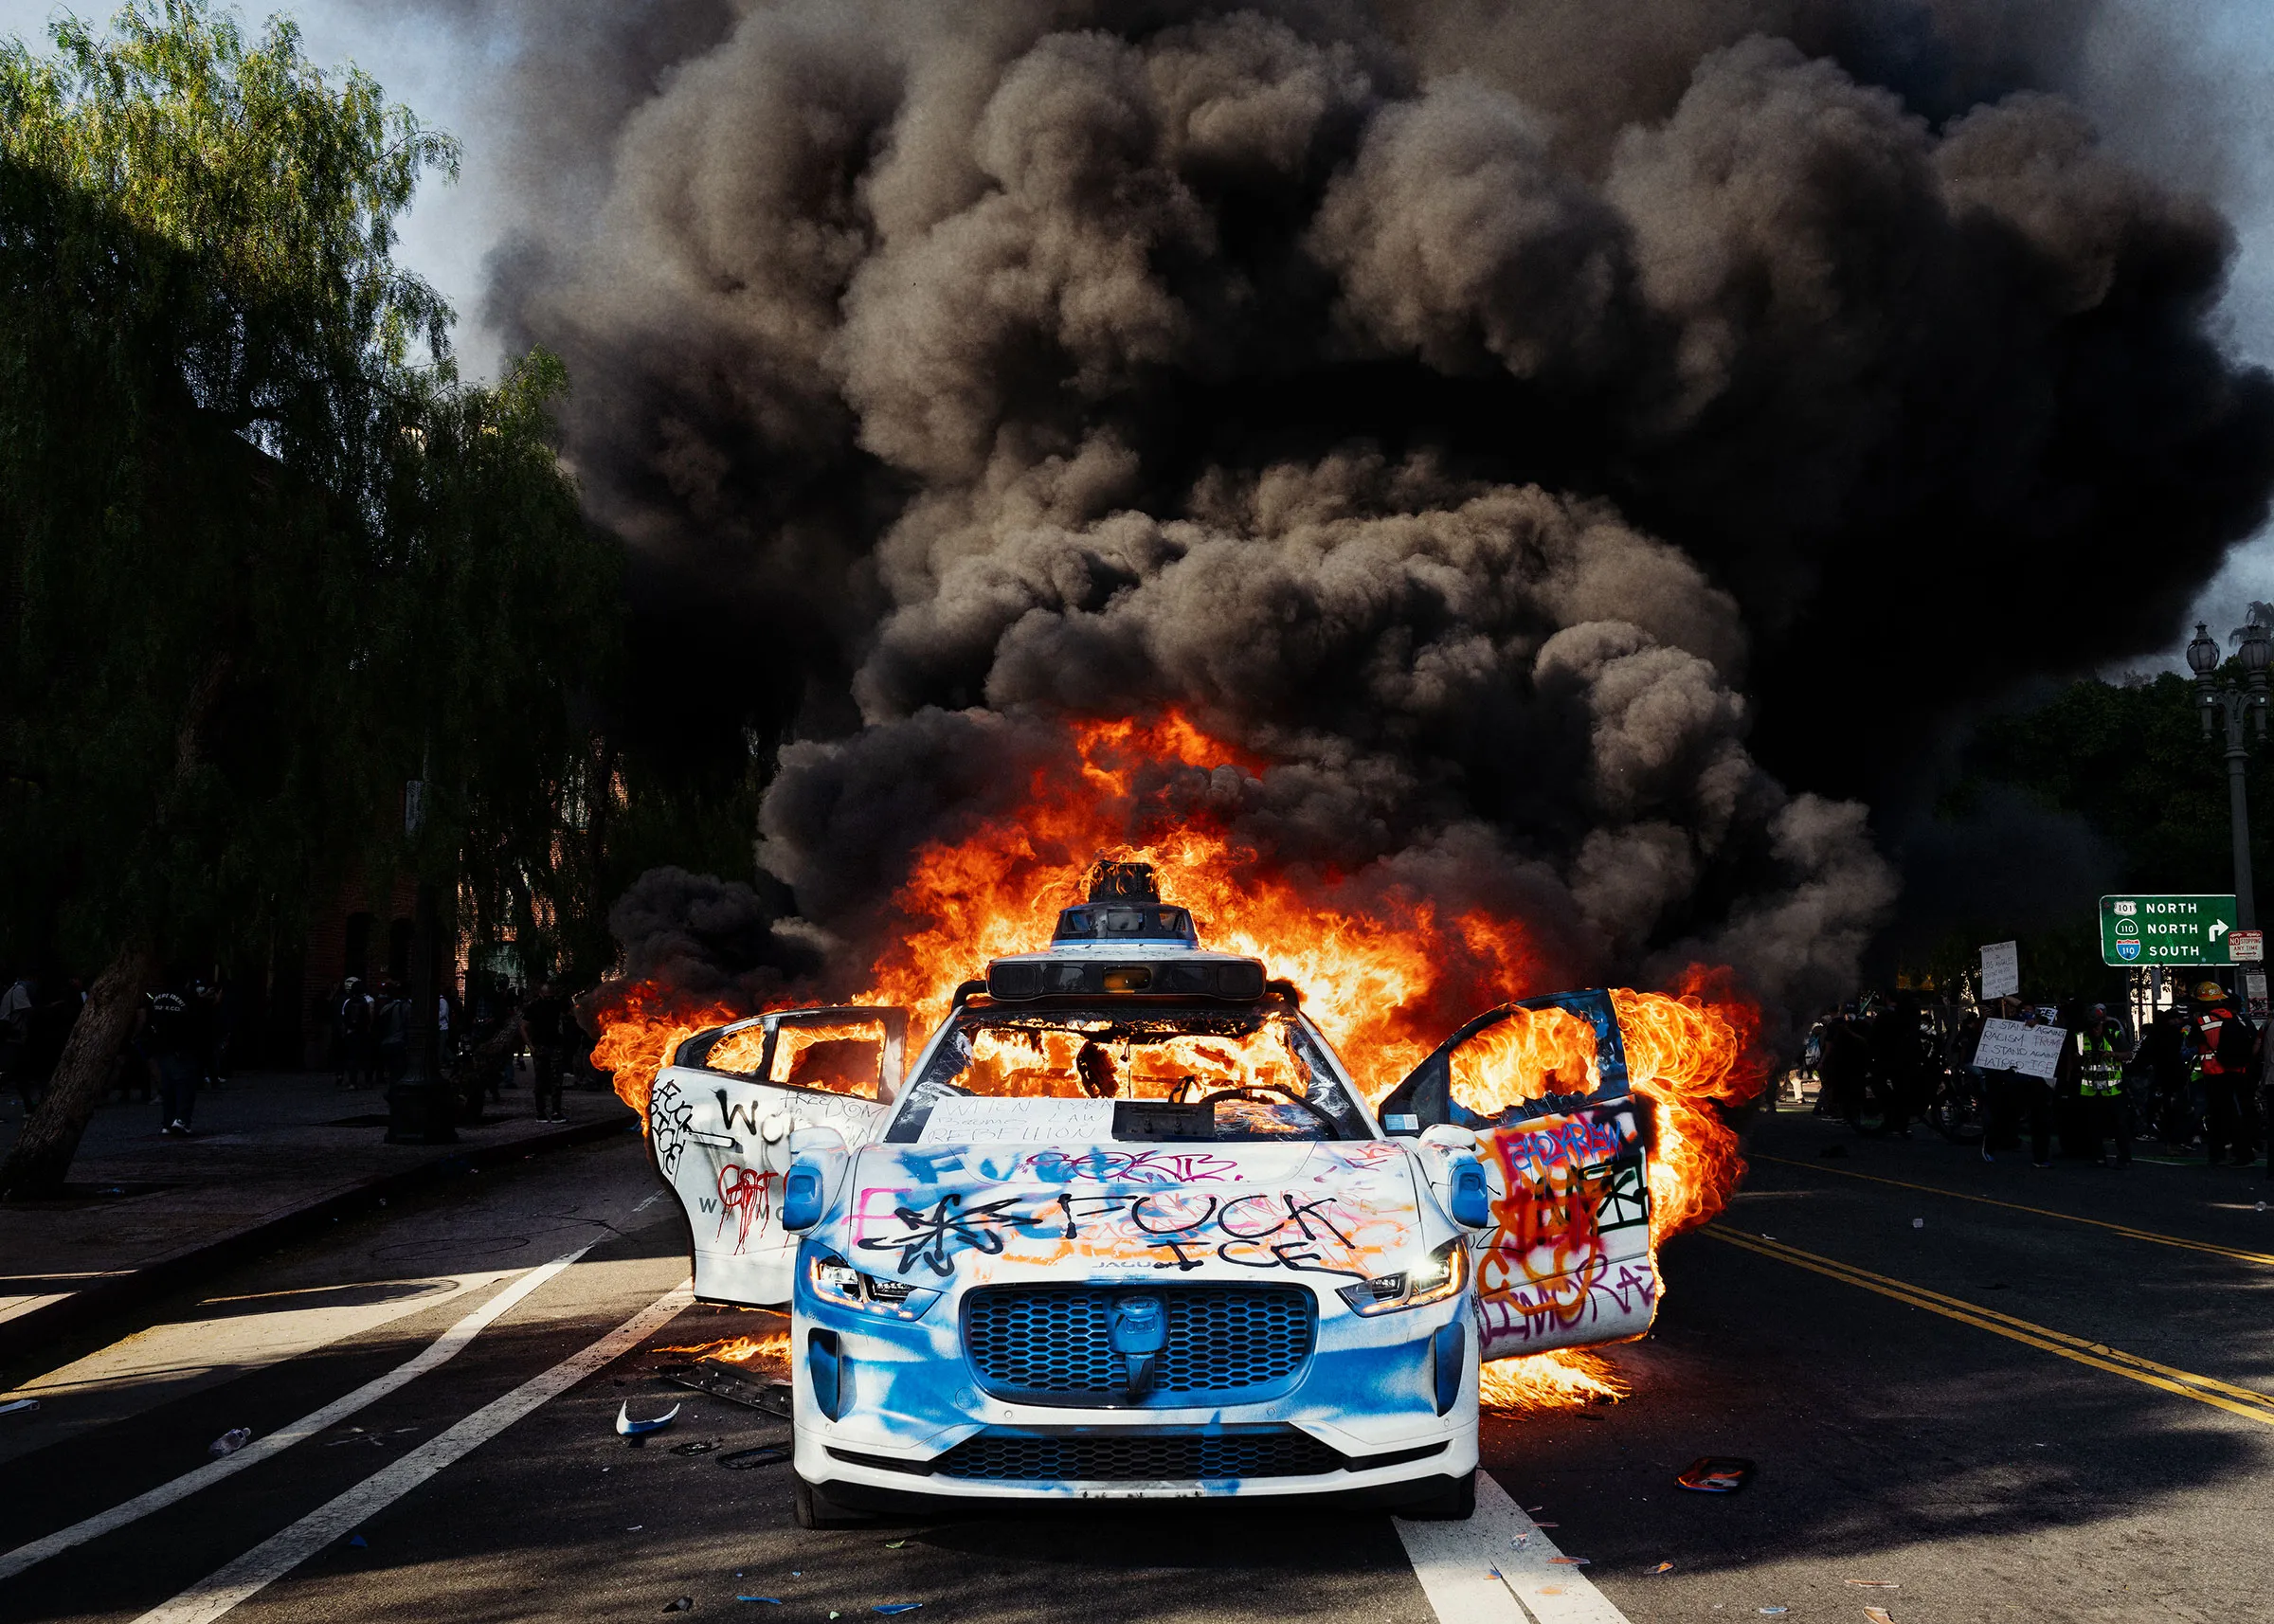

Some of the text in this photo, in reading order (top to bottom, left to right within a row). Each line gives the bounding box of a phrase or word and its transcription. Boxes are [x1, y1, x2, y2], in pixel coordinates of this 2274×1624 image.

[2146, 903, 2197, 913] NORTH
[2147, 924, 2198, 934] NORTH
[2229, 937, 2240, 946] NO
[2122, 946, 2200, 957] 110 SOUTH
[1986, 1020, 1995, 1029] I
[1999, 1020, 2033, 1032] STAND
[1983, 1031, 2025, 1046] RACISM
[1978, 1043, 1989, 1053] I
[1991, 1044, 2028, 1056] STAND
[1976, 1056, 2054, 1074] HATRED ICE
[946, 1098, 1112, 1116] WHEN TYRA
[780, 1089, 888, 1138] FREEDOM
[1048, 1112, 1107, 1123] LAW
[1057, 1193, 1356, 1250] FUCK
[1092, 1260, 1169, 1269] JAGU
[1146, 1239, 1371, 1280] ICE
